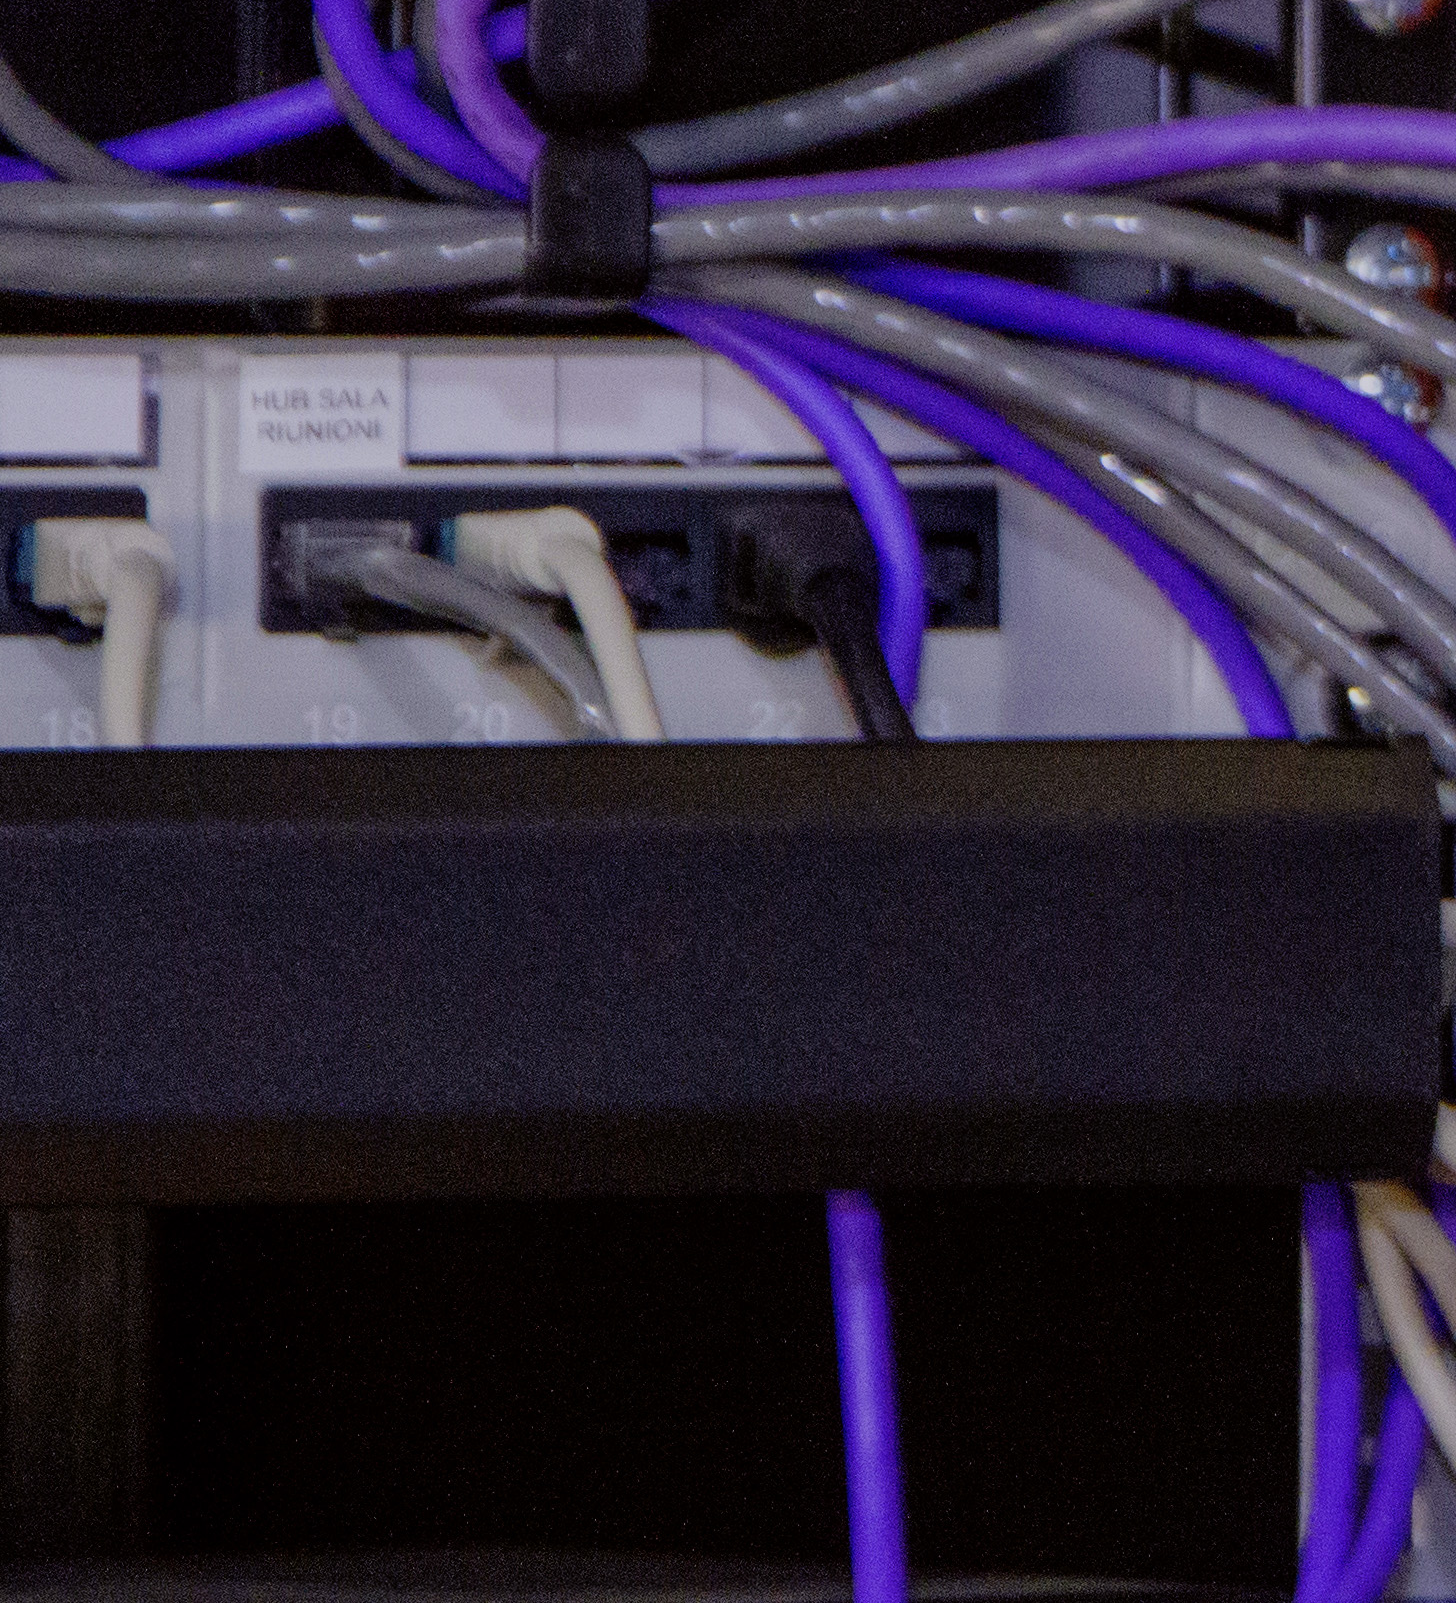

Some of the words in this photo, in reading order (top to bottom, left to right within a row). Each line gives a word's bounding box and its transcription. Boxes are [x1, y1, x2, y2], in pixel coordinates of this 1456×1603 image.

[251, 387, 310, 412] HUB
[318, 386, 390, 411] SALA
[257, 417, 382, 444] RIUNIONI
[41, 707, 96, 746] 18
[303, 703, 359, 742] 19
[453, 701, 514, 740] 20
